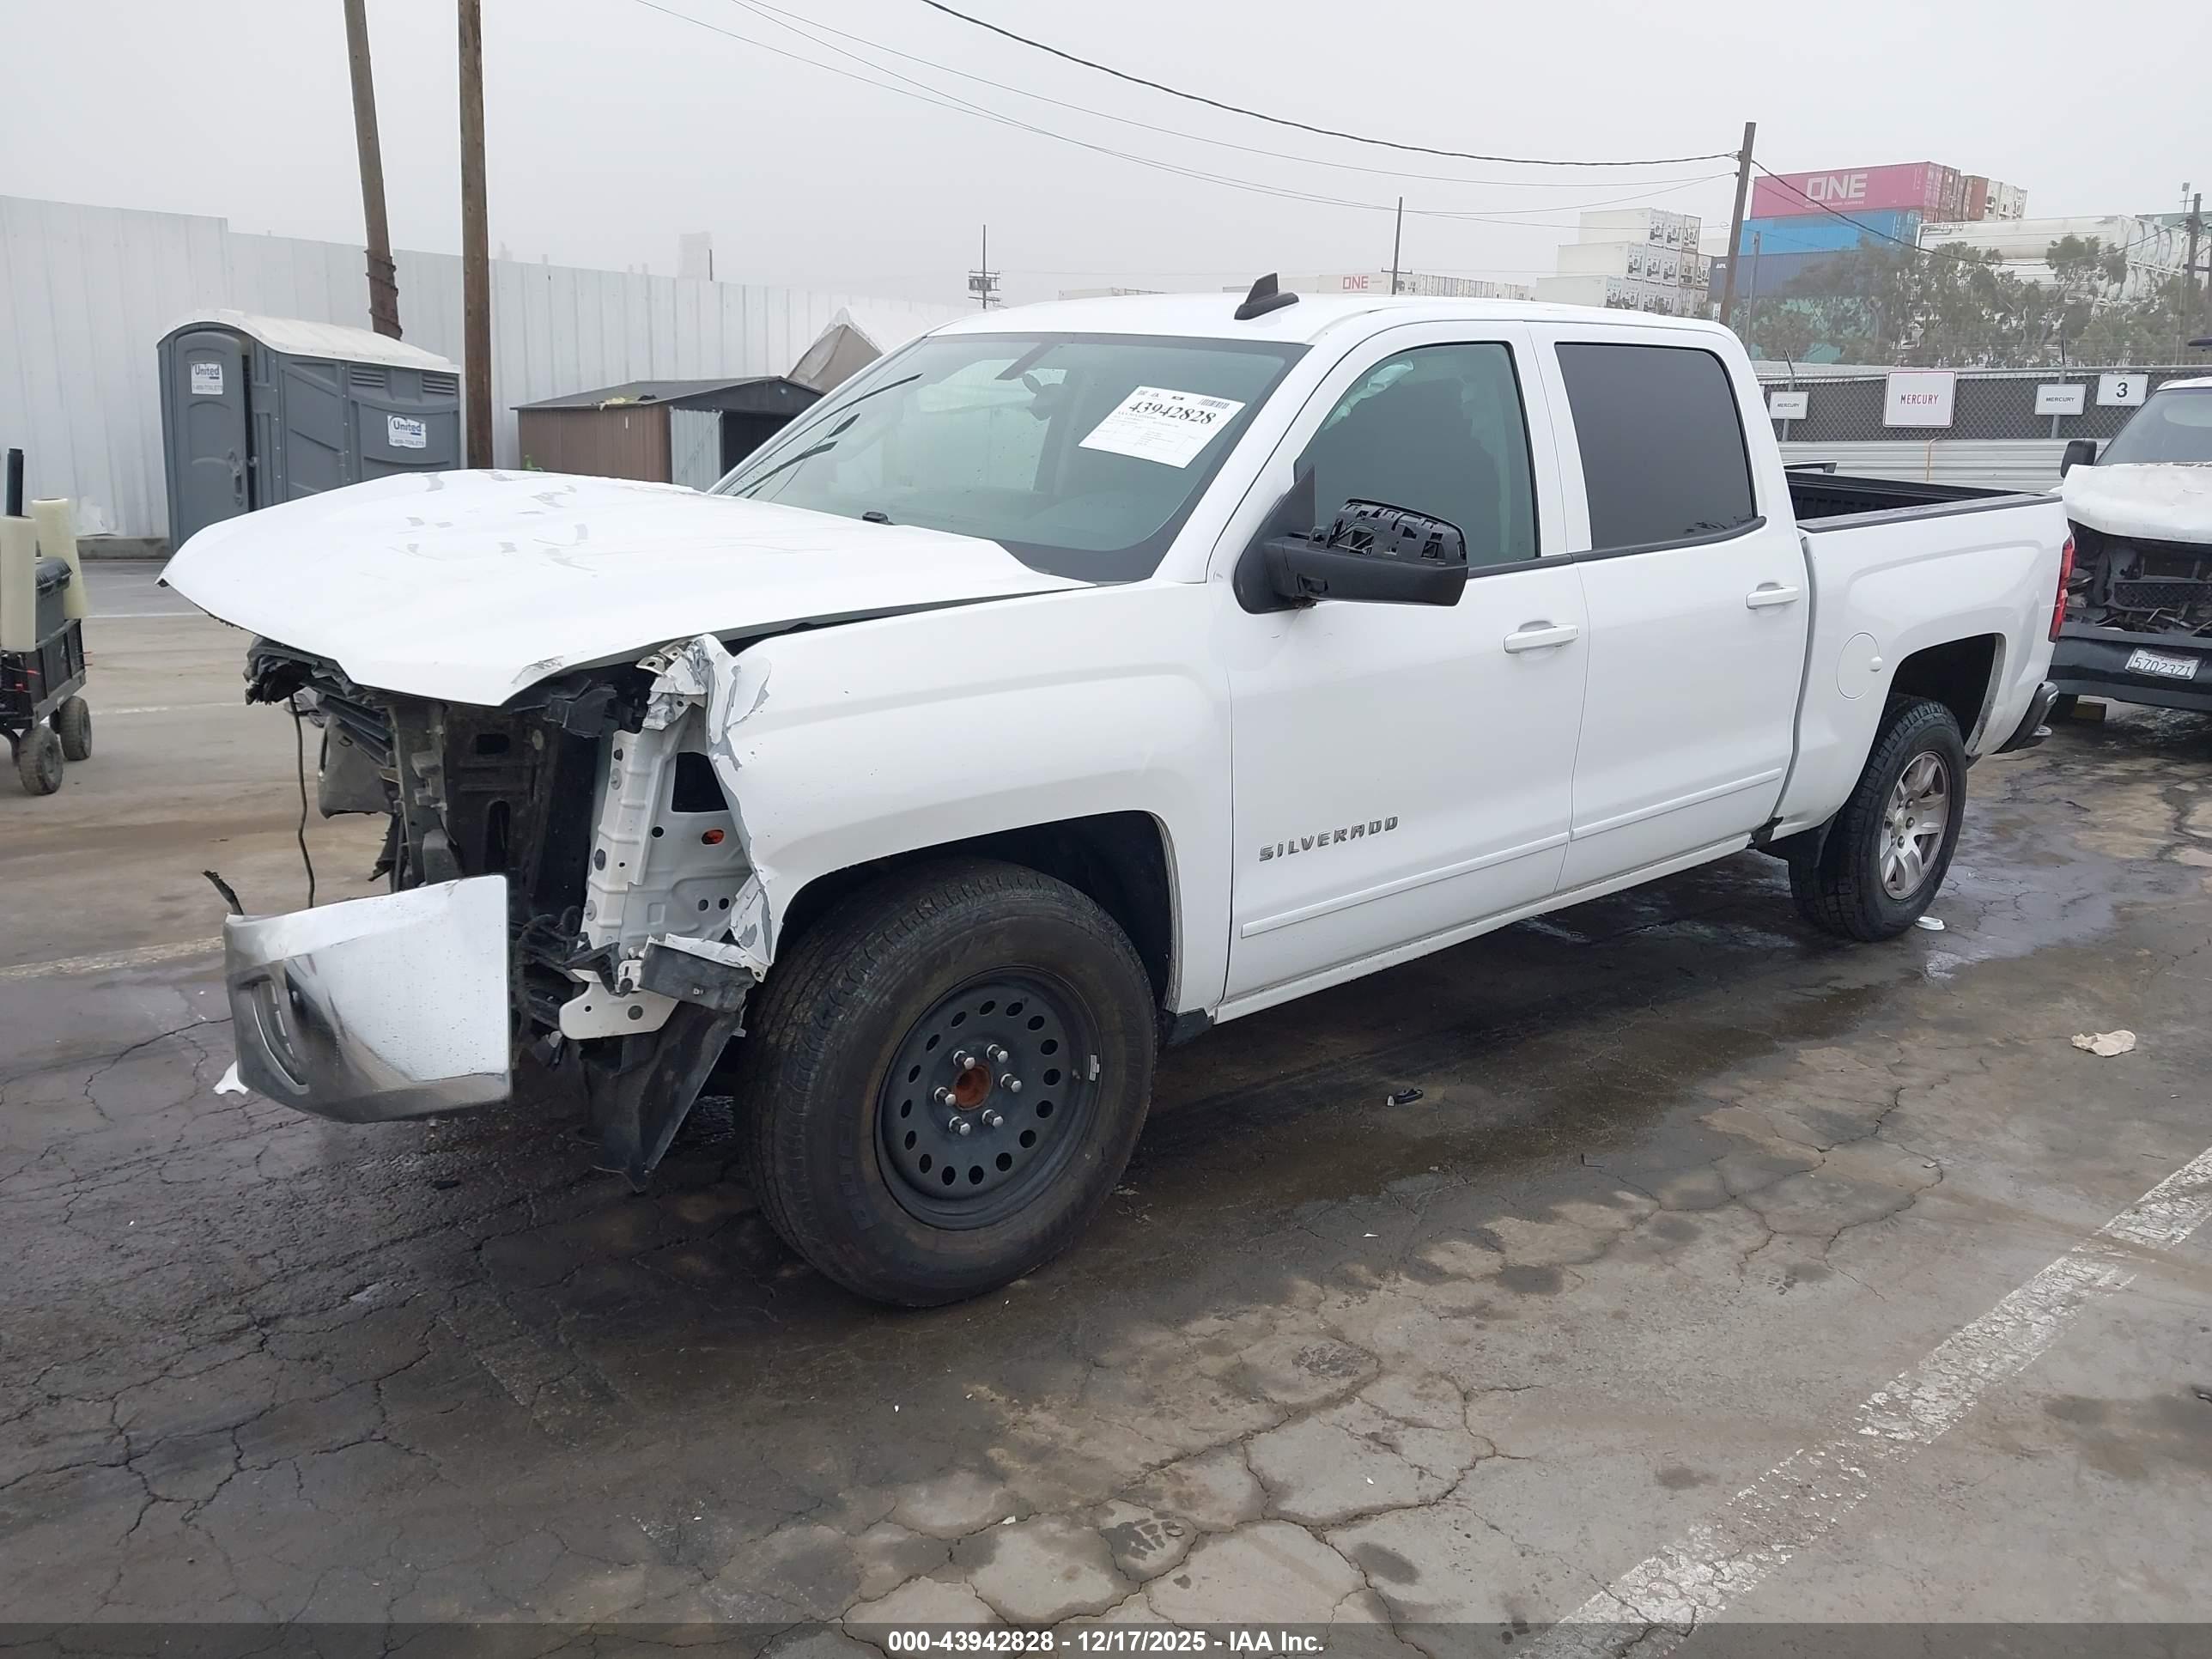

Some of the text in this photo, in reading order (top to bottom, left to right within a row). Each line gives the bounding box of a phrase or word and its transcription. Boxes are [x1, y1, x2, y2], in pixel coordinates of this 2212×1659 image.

[1807, 173, 1868, 201] ONE
[1343, 276, 1369, 289] ONE
[195, 365, 220, 375] United
[2116, 382, 2128, 398] 3
[1899, 394, 1939, 404] MERCURY
[1129, 401, 1217, 425] 43942828
[393, 420, 422, 432] United
[1259, 816, 1399, 862] SILVERADO
